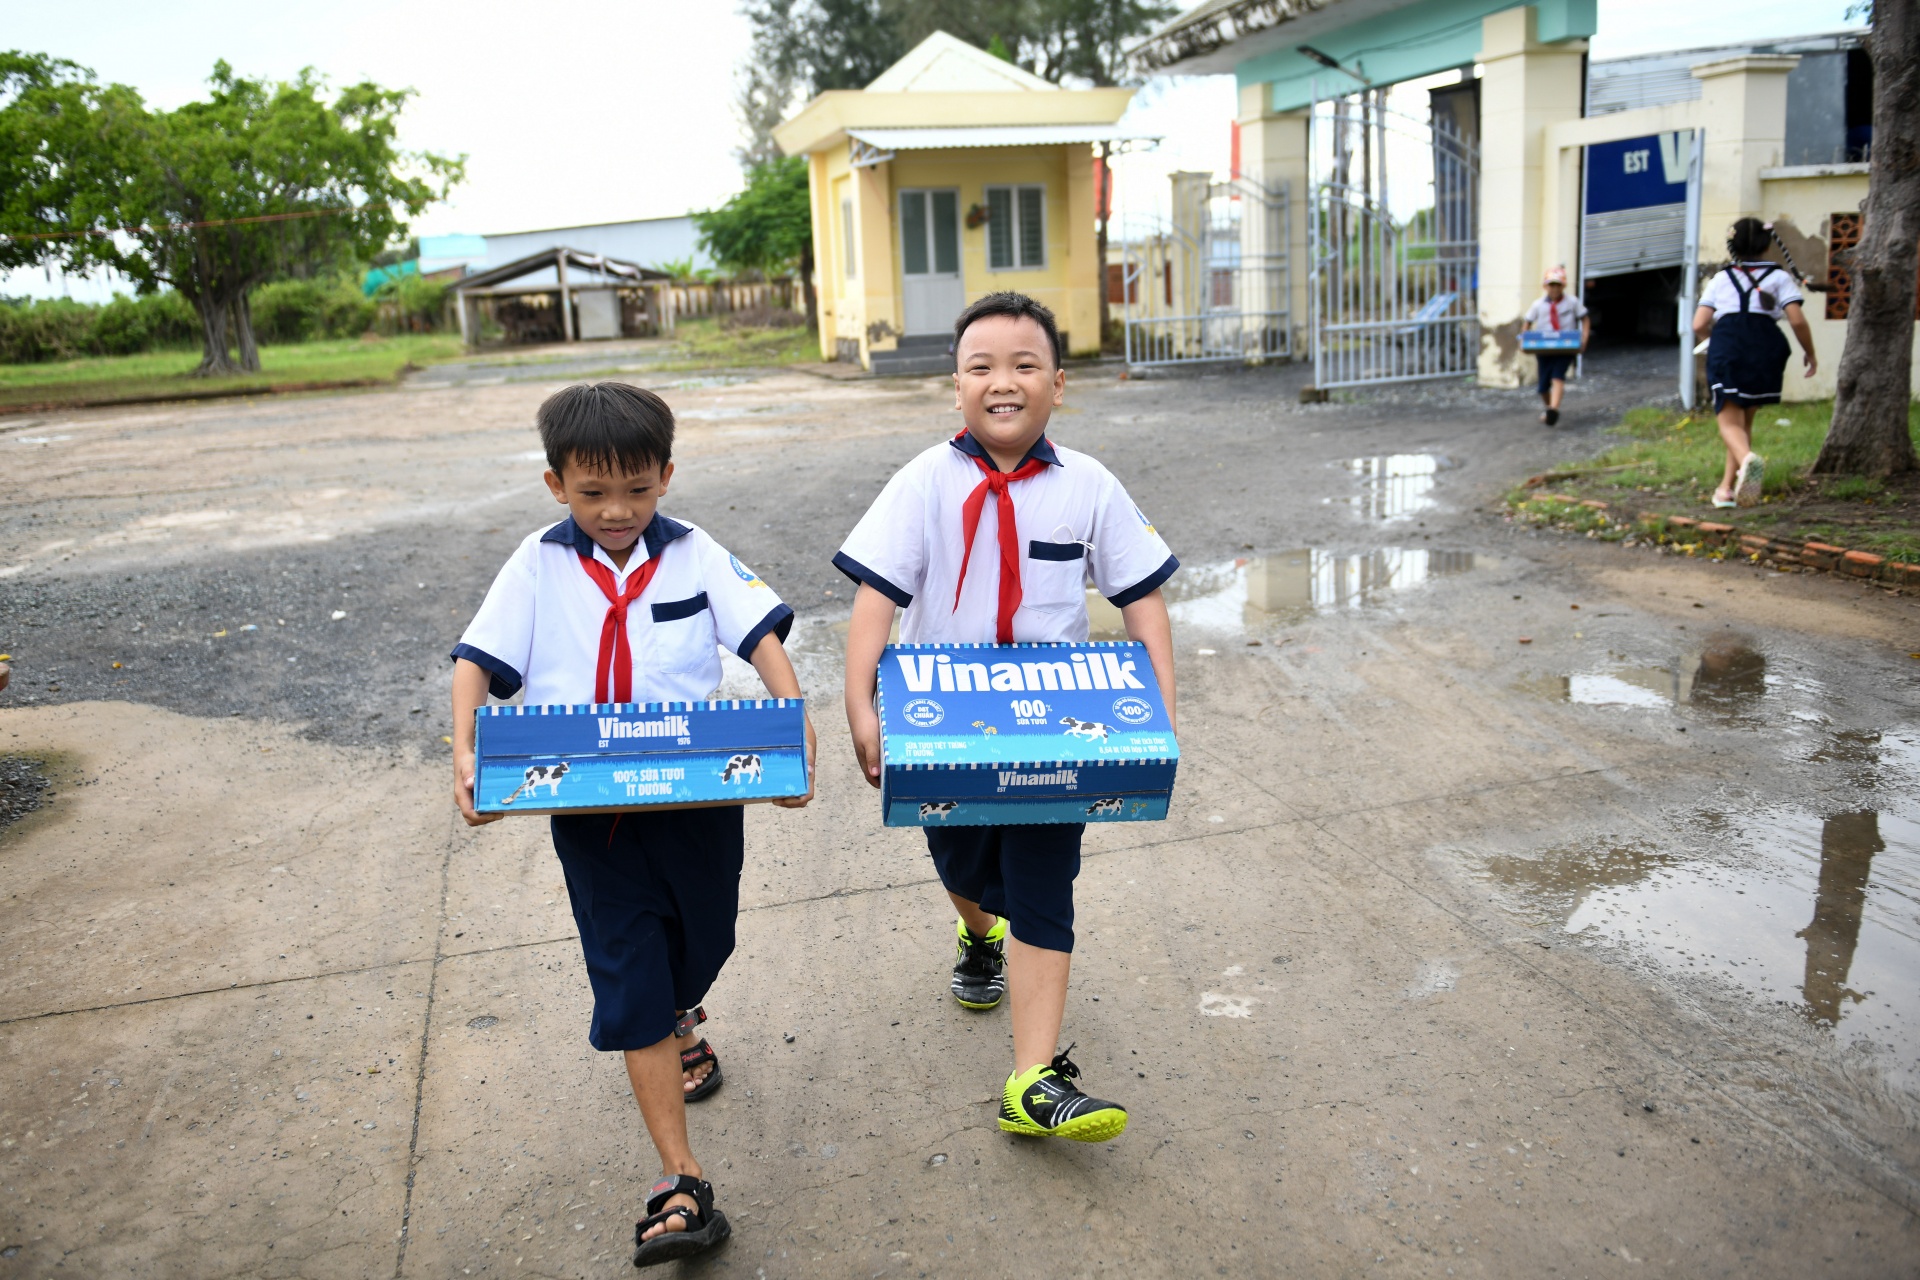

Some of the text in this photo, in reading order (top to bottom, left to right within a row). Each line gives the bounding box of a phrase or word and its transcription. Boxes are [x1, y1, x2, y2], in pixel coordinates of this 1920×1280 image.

[1623, 149, 1650, 175] EST
[896, 653, 1146, 692] Vinamilk
[598, 715, 691, 738] Vinamilk
[598, 737, 691, 748] EST 1976
[612, 770, 638, 784] 100%
[998, 769, 1078, 786] Vinamilk
